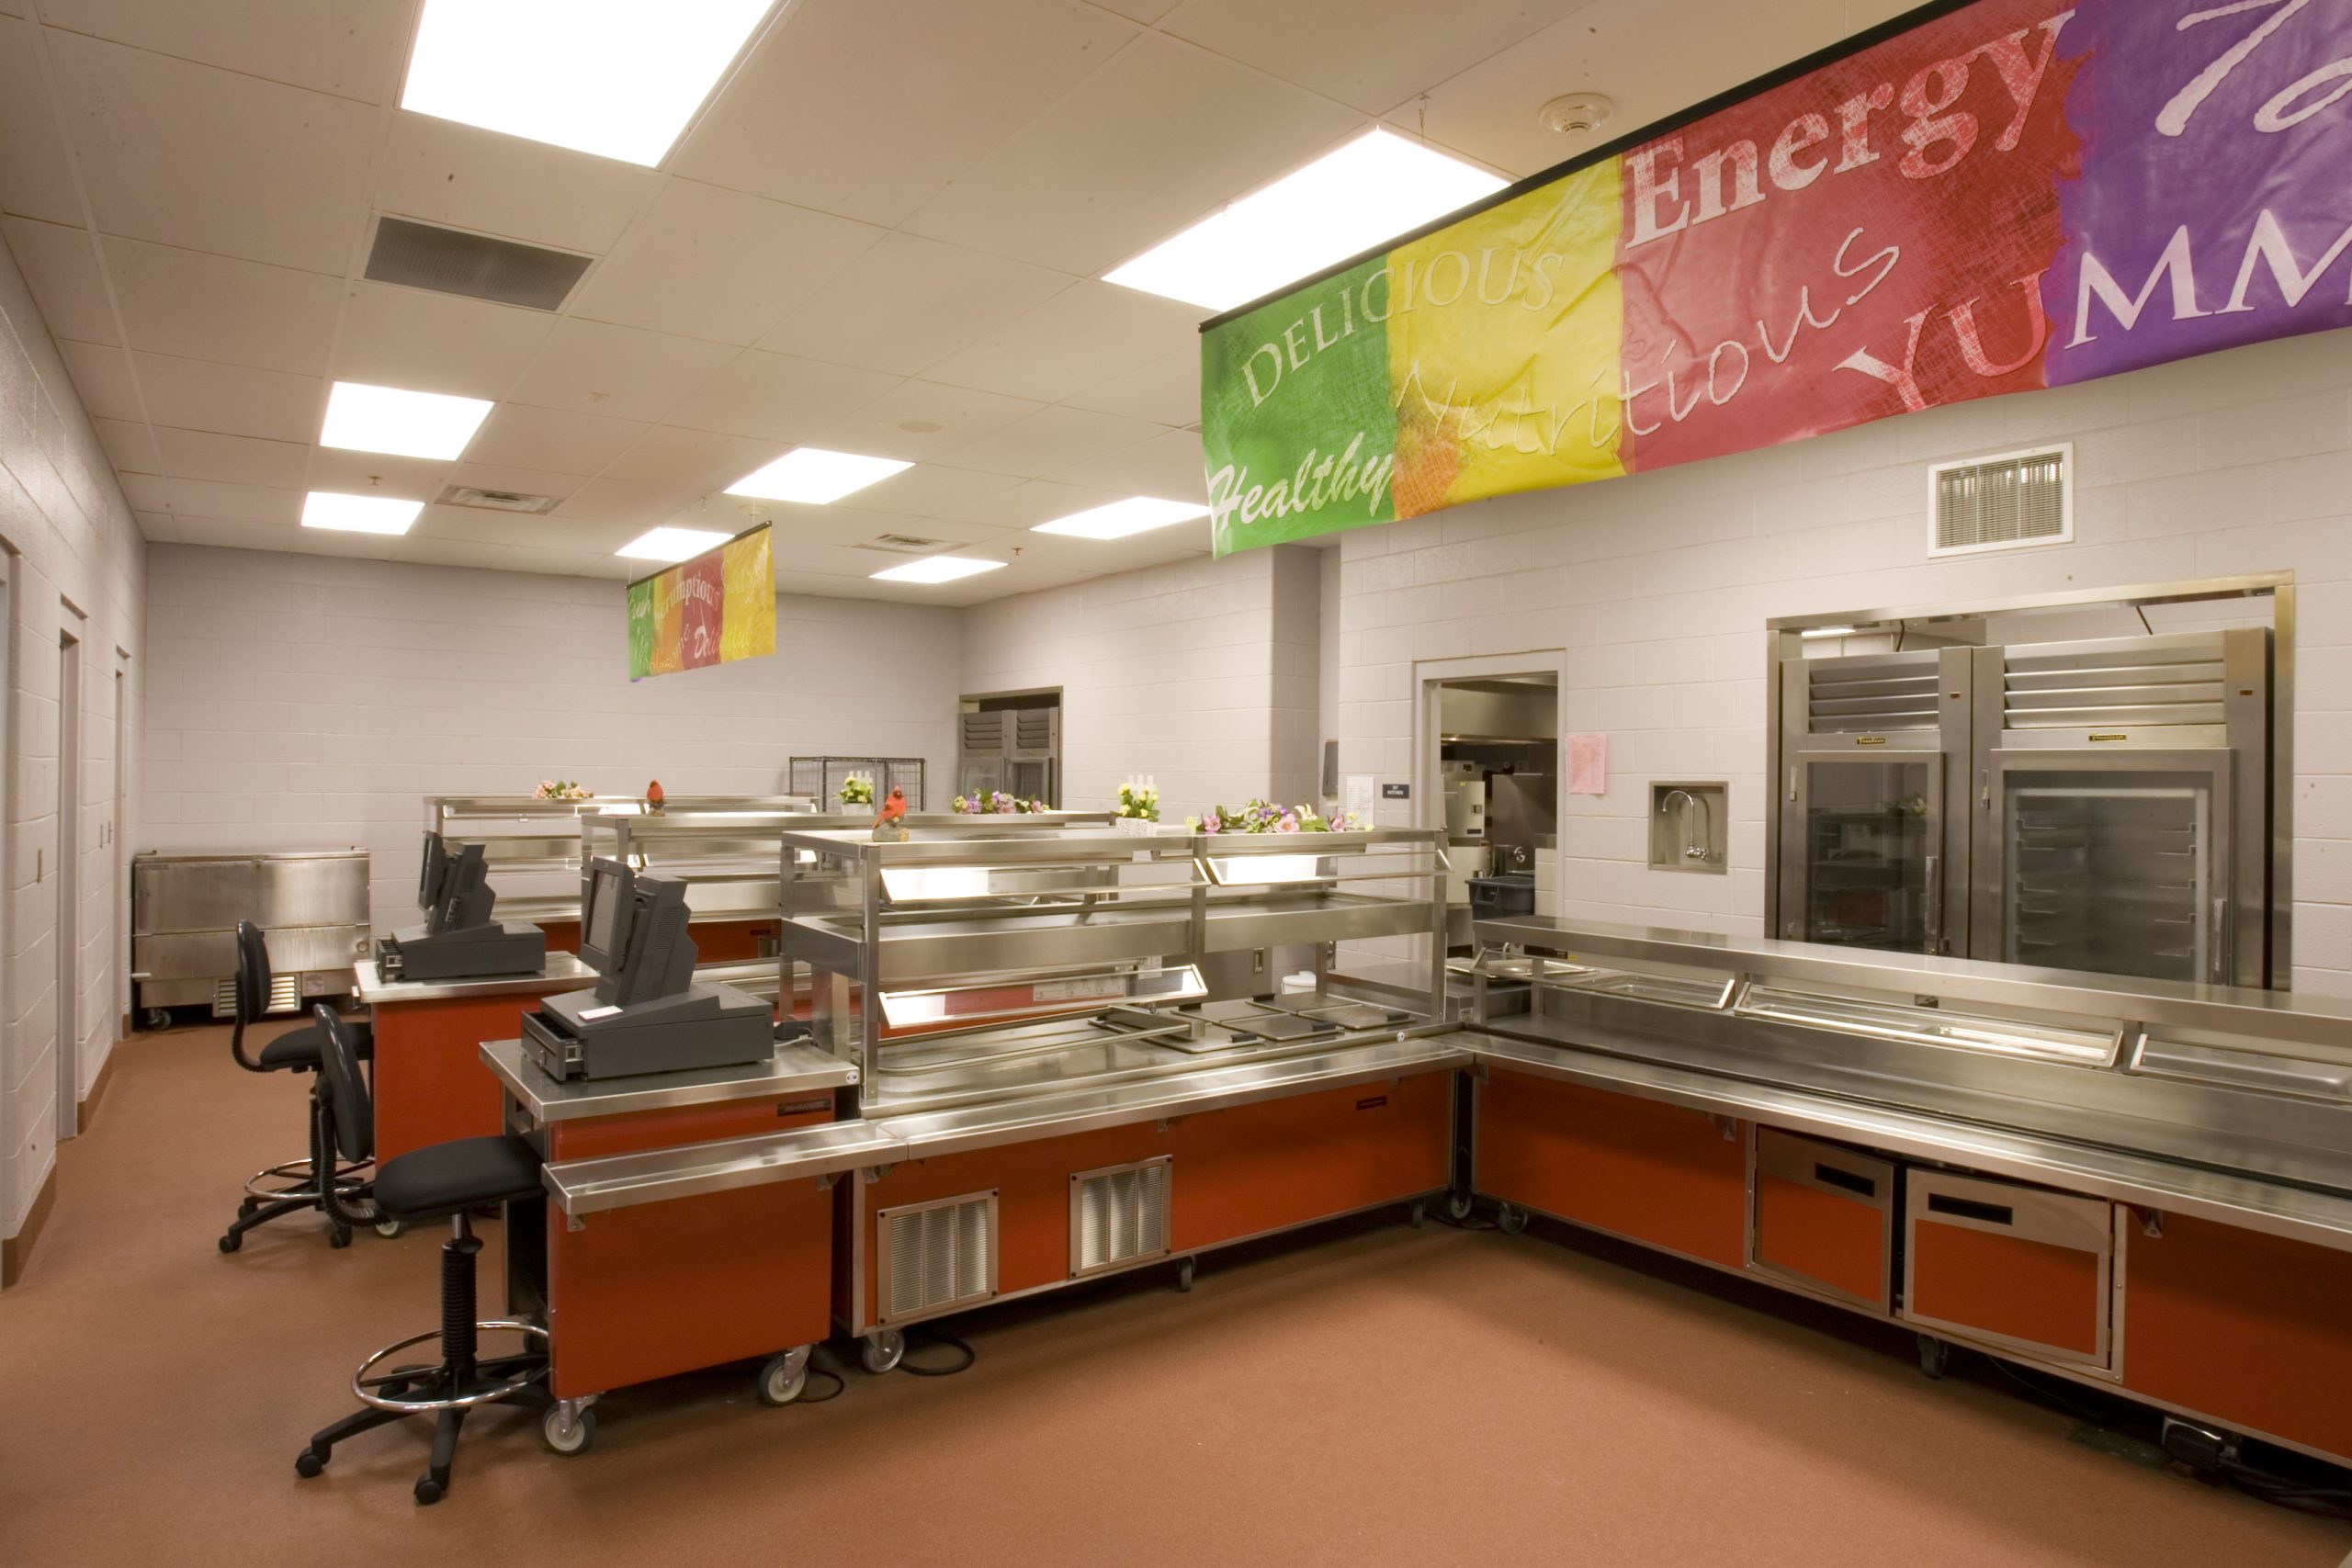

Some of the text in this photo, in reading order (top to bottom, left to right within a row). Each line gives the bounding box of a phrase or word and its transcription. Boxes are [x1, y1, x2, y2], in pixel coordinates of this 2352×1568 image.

[1625, 8, 2076, 251] Energy
[1240, 248, 1564, 411] DELICIOUS
[1396, 227, 1900, 457] Nutritious
[1209, 431, 1395, 532] Healthy
